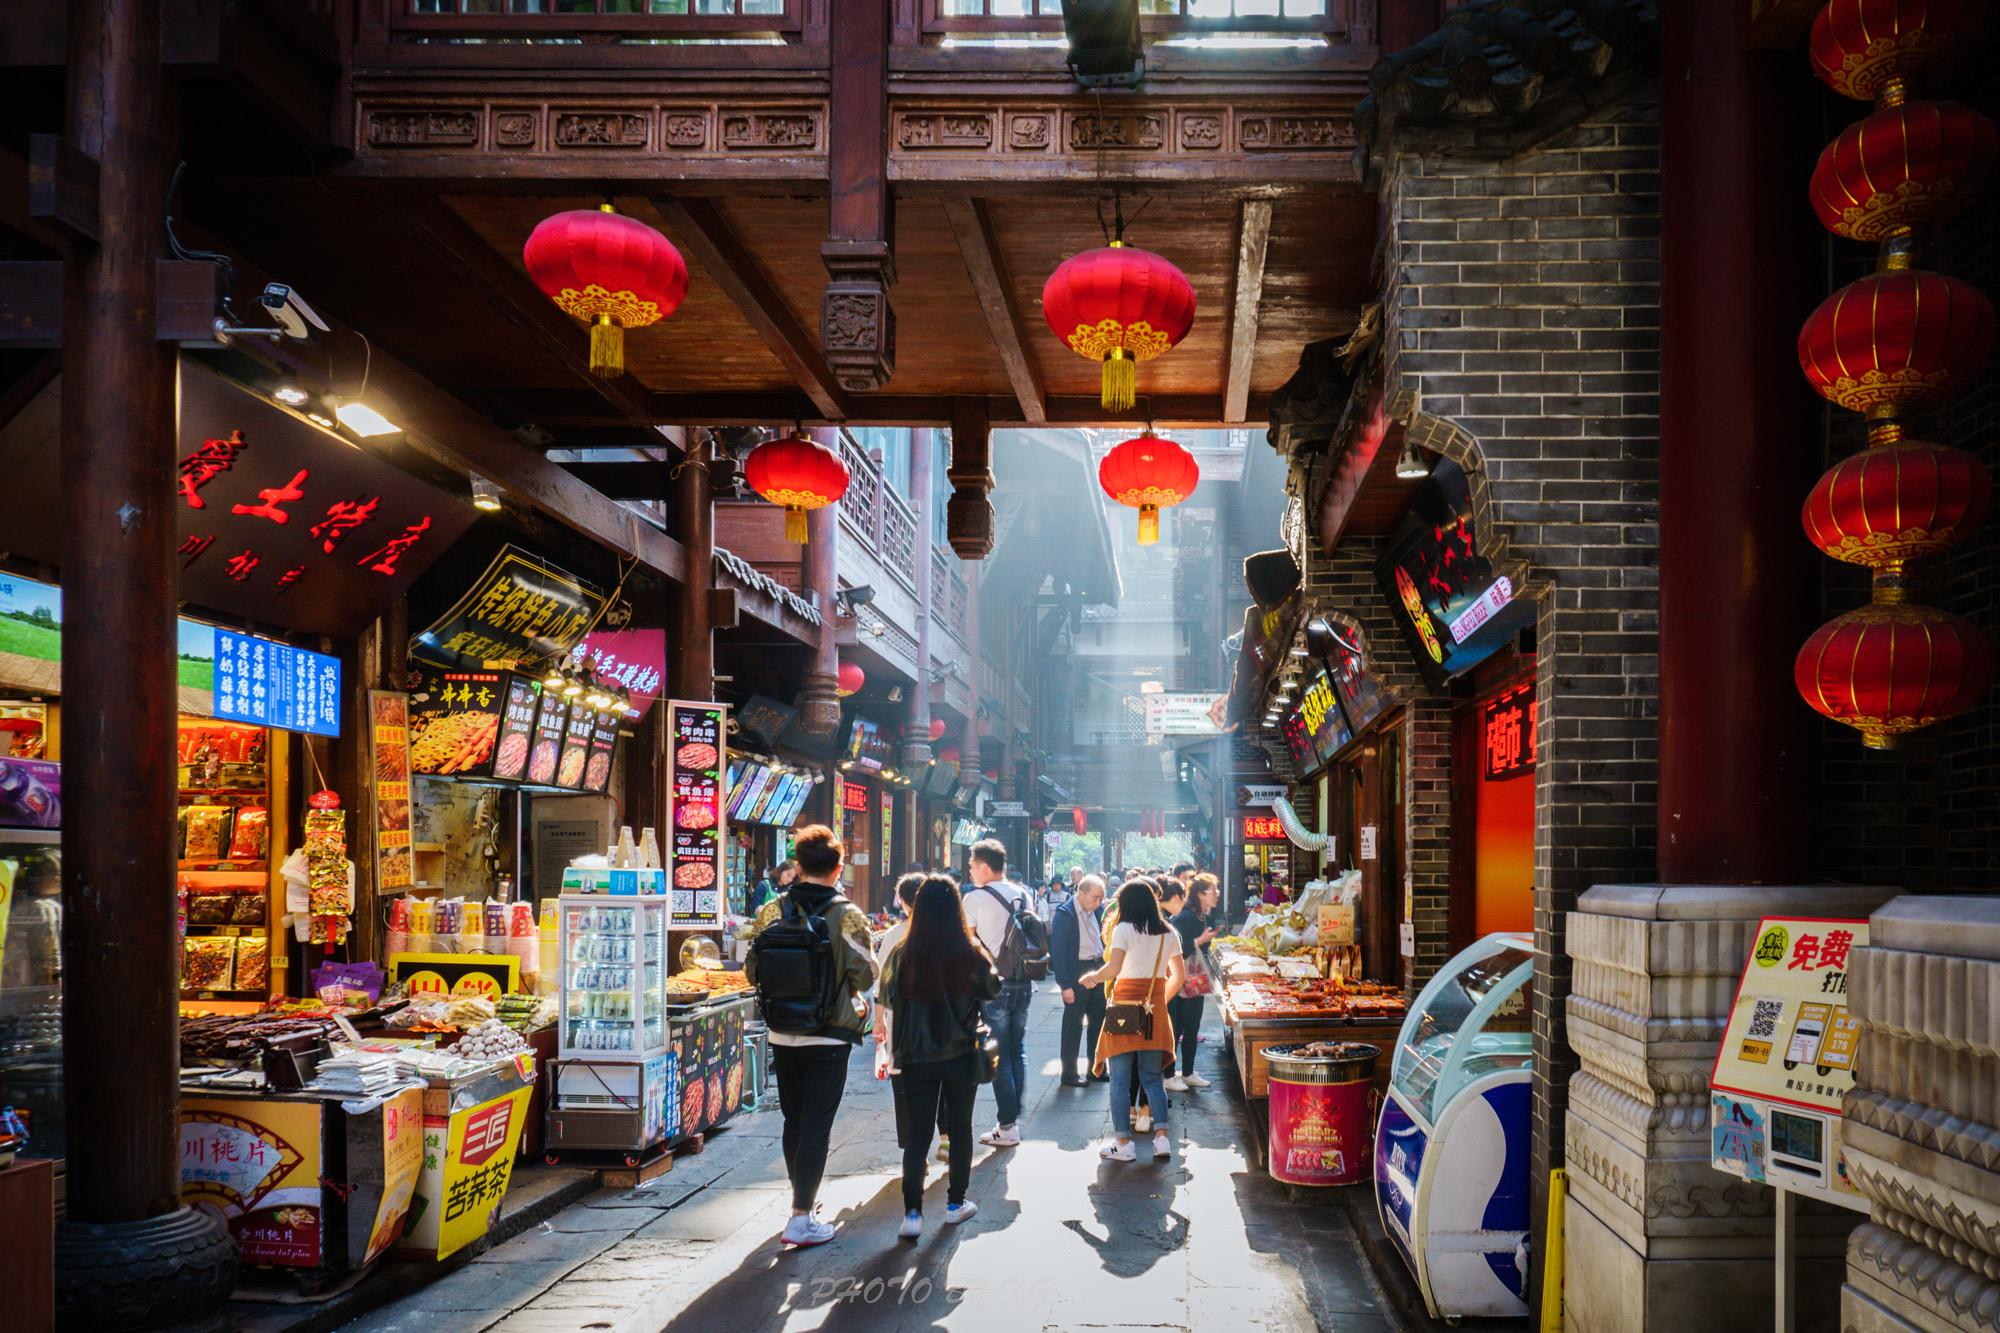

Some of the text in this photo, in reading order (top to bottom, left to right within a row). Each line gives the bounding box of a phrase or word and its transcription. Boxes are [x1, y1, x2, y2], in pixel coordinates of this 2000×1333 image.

[466, 575, 589, 646] 传统特色小吃
[440, 681, 497, 707] 串串香
[680, 726, 716, 738] 烤肉串
[1486, 702, 1537, 769] 超市
[679, 786, 715, 797] 鱿鱼须
[677, 847, 714, 856] 疯狂的土豆
[184, 1136, 266, 1168] 川桃片
[424, 1132, 442, 1170] 健康
[446, 1156, 510, 1223] 苦荞茶
